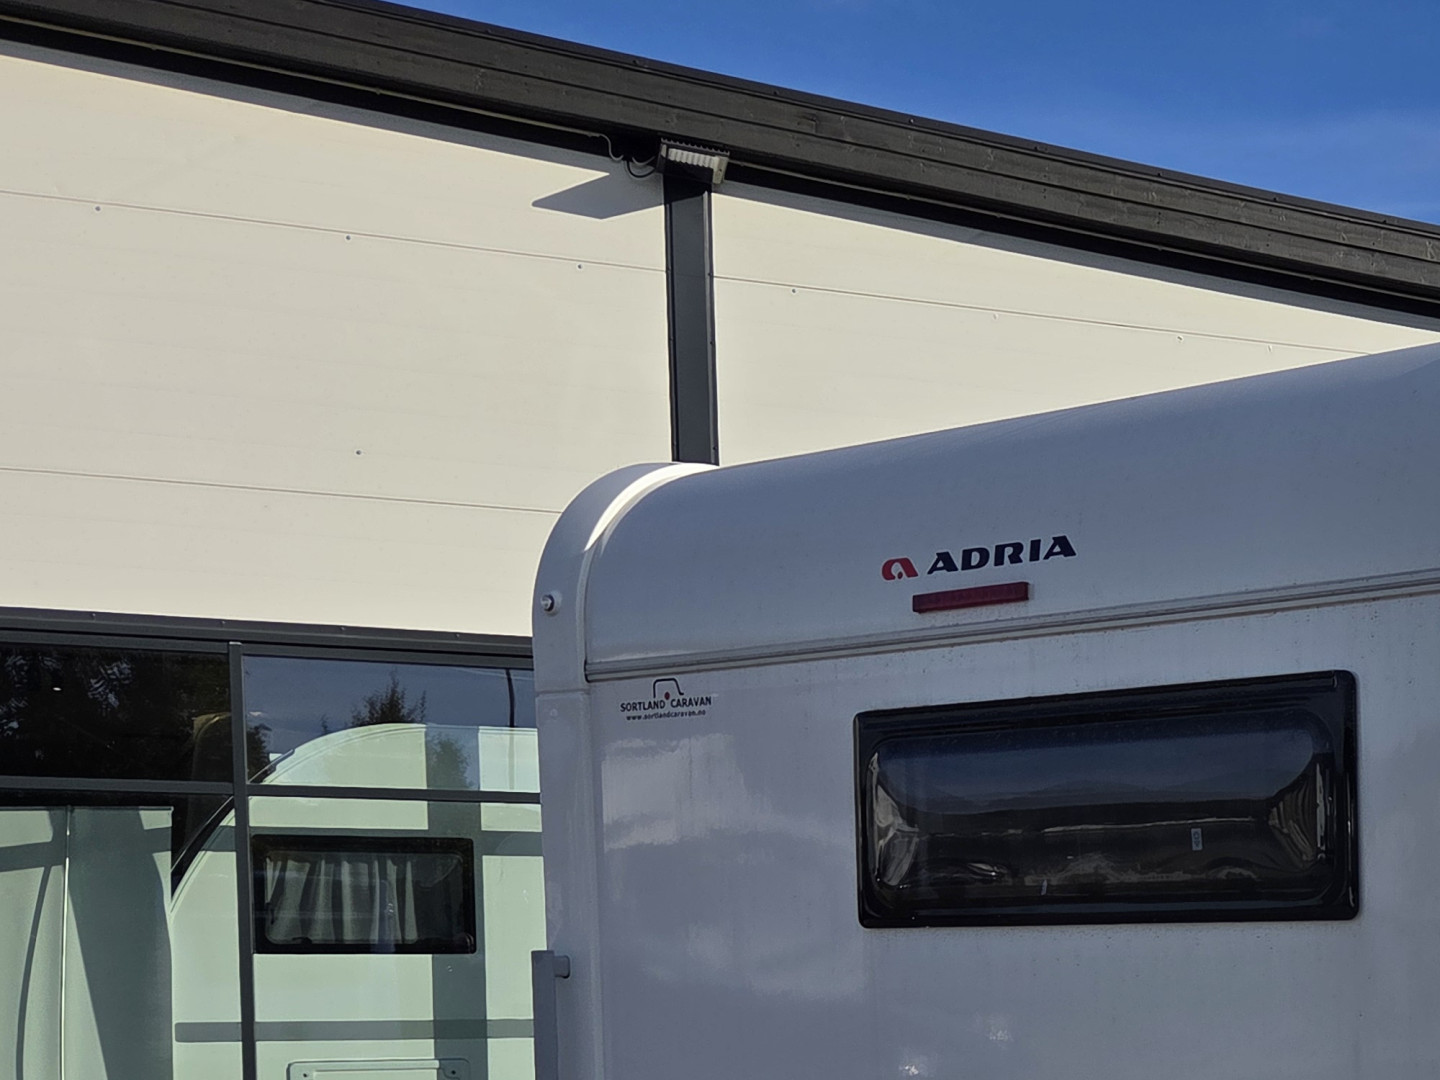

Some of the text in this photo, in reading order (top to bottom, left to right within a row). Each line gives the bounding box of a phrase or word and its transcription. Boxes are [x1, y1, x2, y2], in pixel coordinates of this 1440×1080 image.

[927, 535, 1077, 575] ADRIA
[620, 696, 711, 713] SORTLAND CARAVAN
[626, 710, 706, 721] www.sortlandcaravan.no
